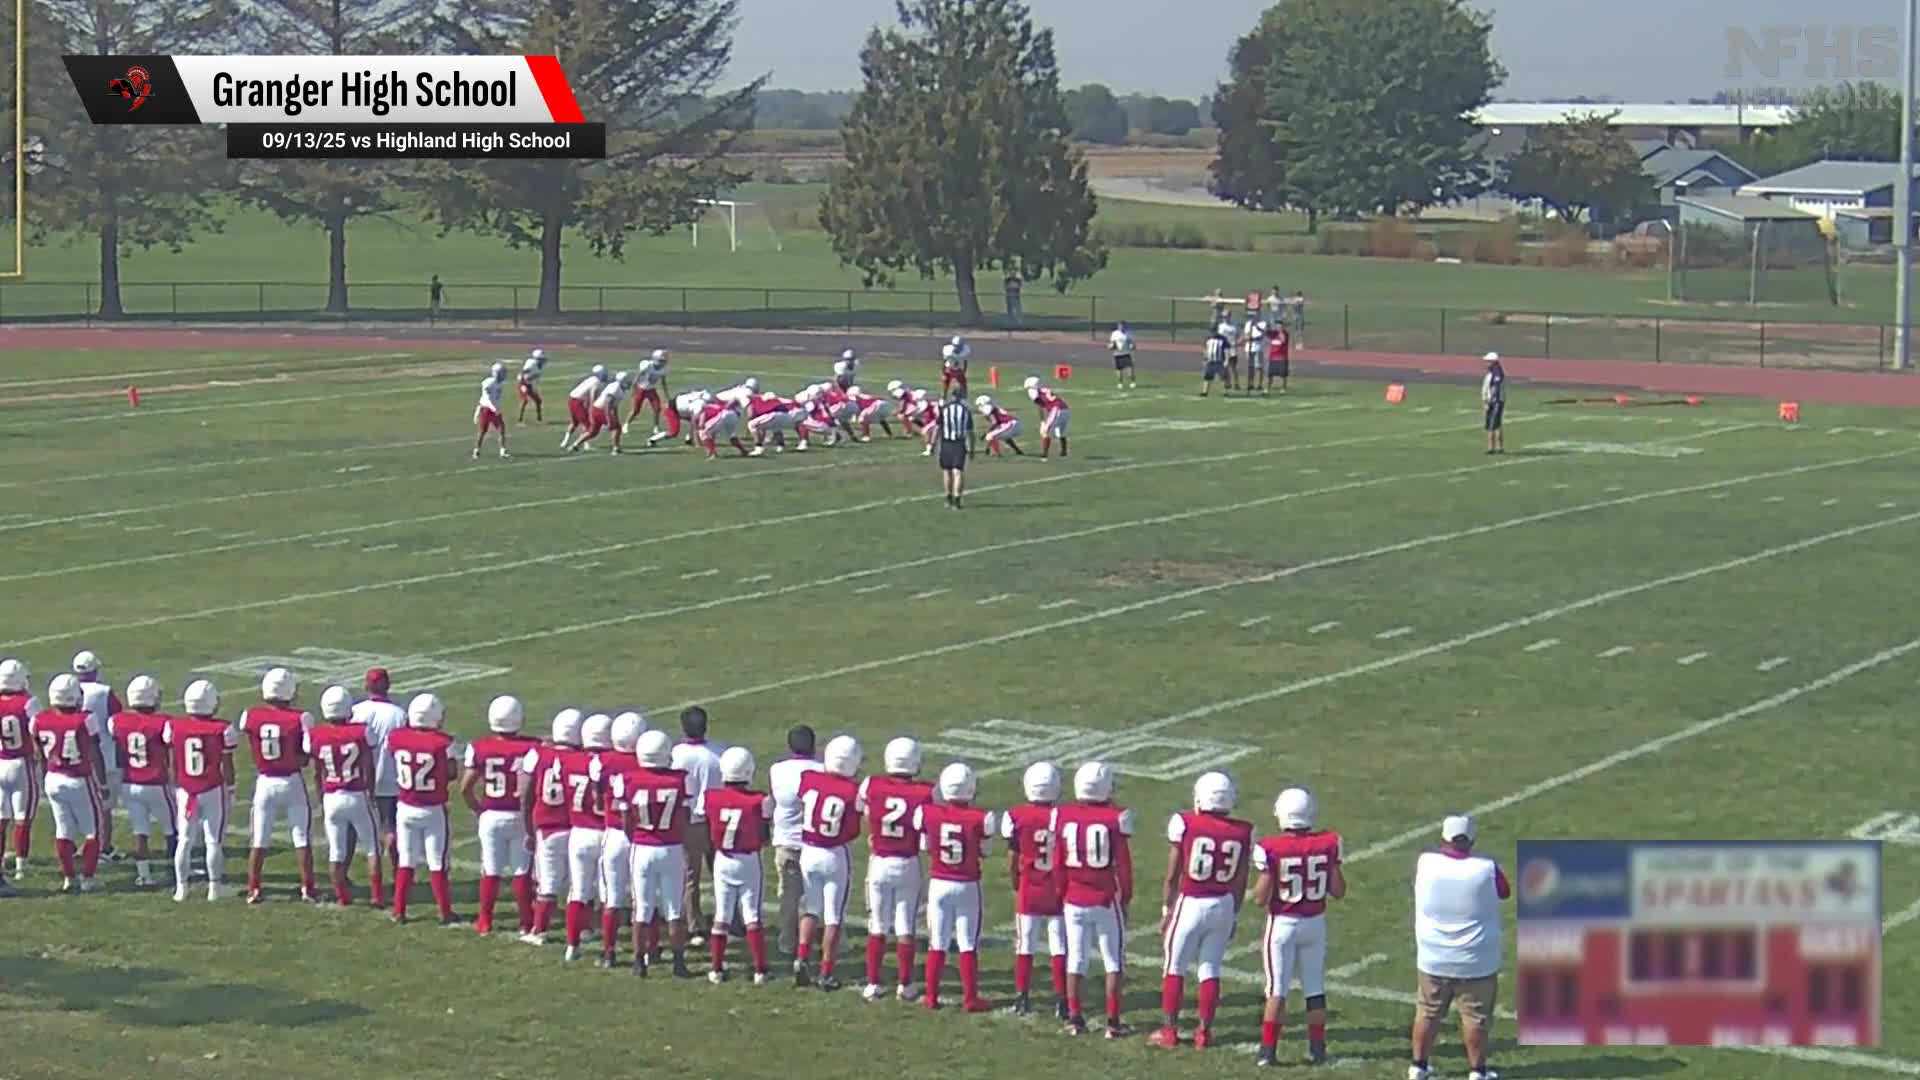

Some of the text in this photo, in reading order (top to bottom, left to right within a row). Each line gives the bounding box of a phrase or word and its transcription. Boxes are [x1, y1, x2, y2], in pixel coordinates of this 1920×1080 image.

[0, 715, 22, 749] 9
[39, 730, 82, 765] 24
[127, 732, 147, 768] 9
[260, 723, 280, 760] 8
[184, 737, 204, 776] 6
[319, 742, 360, 783] 12
[393, 749, 436, 791] 62
[632, 789, 678, 830] 17
[719, 809, 742, 849] 7
[802, 789, 845, 837] 19
[882, 798, 905, 838] 2
[939, 823, 963, 865] 5
[1062, 822, 1110, 868] 10
[1188, 837, 1242, 883] 63
[1278, 855, 1329, 904] 55
